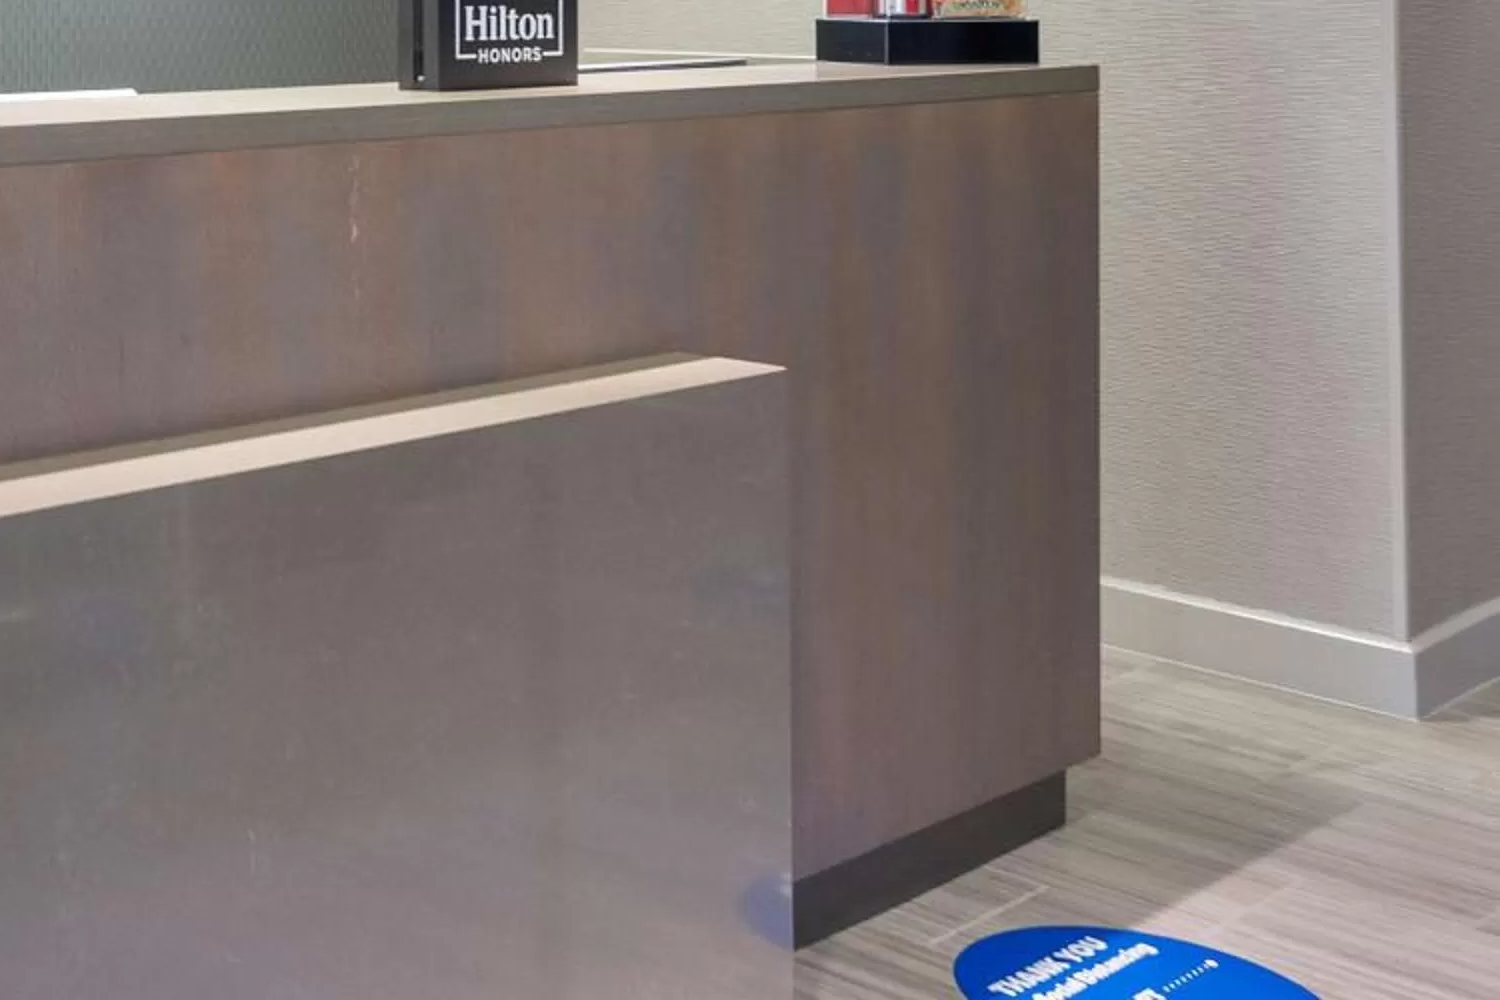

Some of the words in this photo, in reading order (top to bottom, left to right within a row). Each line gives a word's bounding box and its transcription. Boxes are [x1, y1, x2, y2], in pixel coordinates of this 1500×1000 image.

[464, 4, 555, 42] Hilton
[477, 46, 543, 64] HONORS
[986, 956, 1071, 997] THANK
[1052, 935, 1108, 963] YOU
